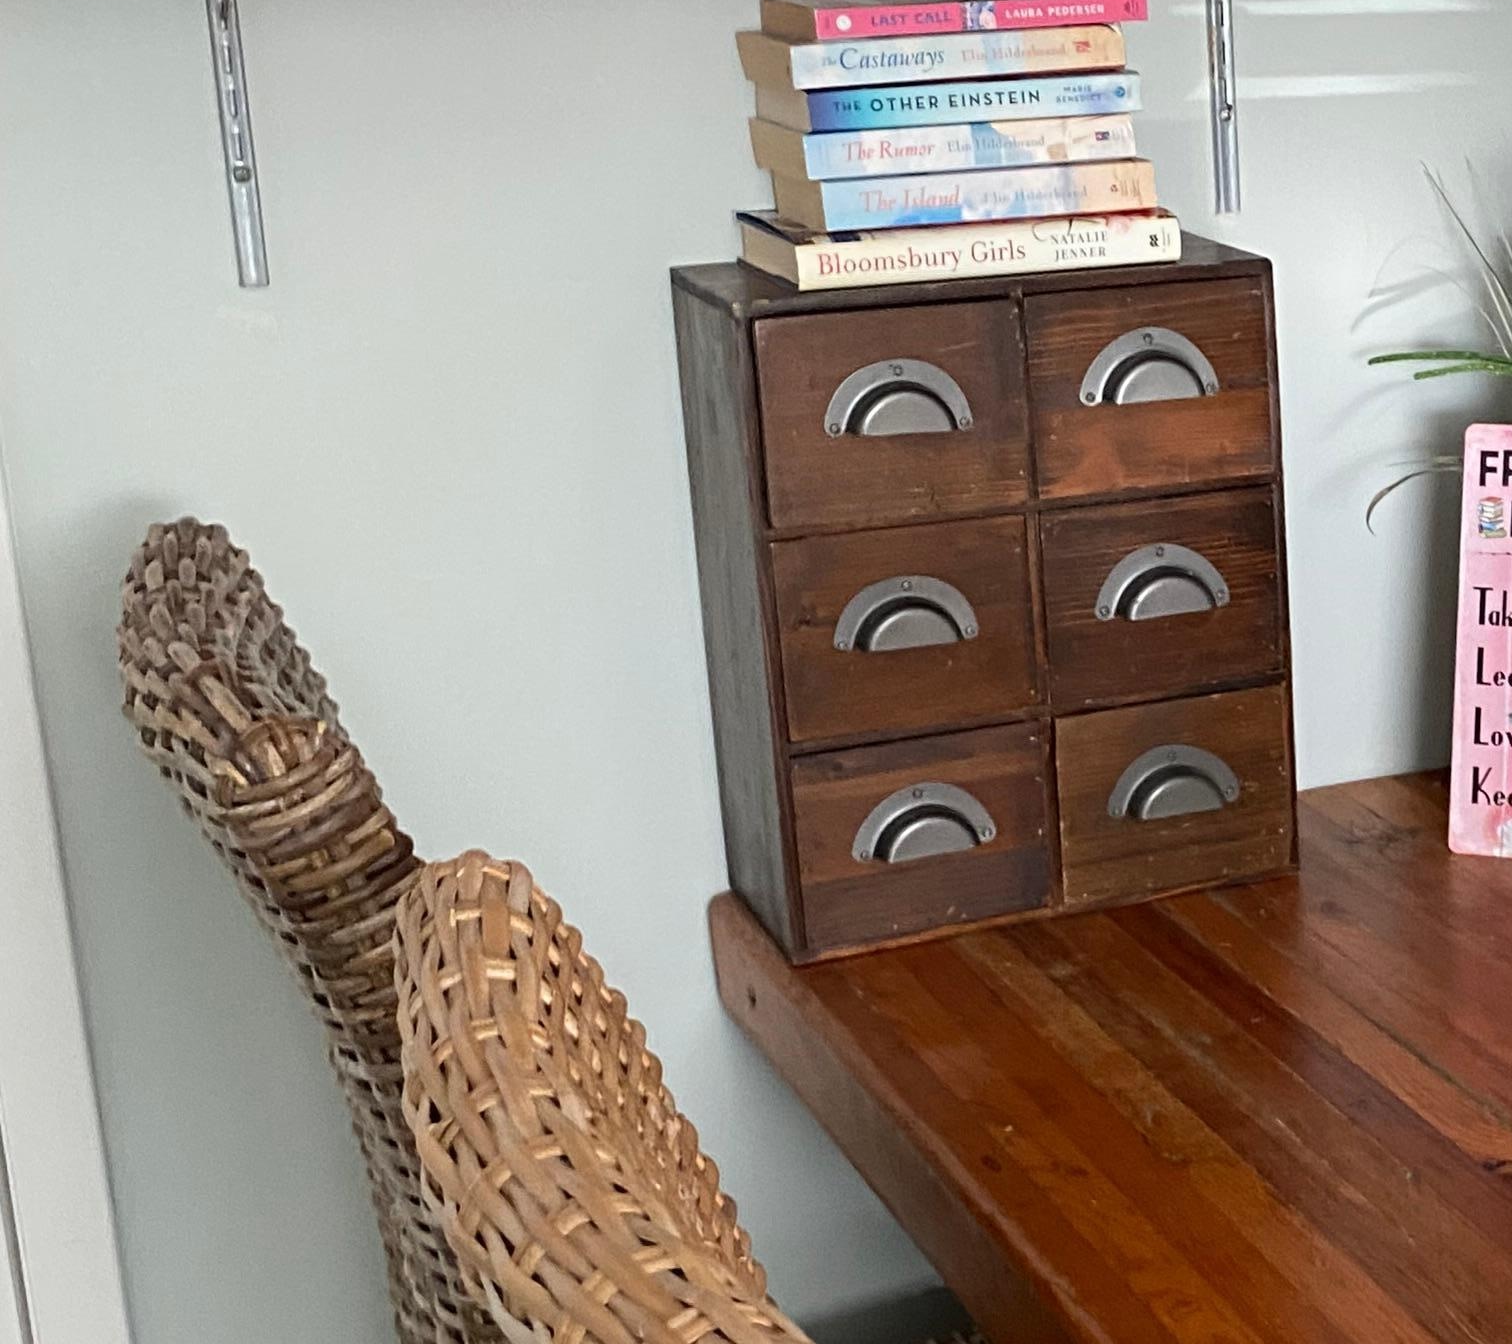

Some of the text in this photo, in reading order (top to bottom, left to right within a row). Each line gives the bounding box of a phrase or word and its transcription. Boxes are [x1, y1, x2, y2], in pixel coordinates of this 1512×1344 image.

[871, 4, 1105, 26] LAST CALL LAURA PEDERSEN
[839, 47, 945, 69] Castaways
[871, 90, 1040, 111] OTHER EINSTEIN
[843, 139, 935, 161] The Rumor
[859, 186, 960, 212] The Island
[818, 239, 1025, 274] Bloomsbury Girls
[1055, 247, 1107, 260] JENNER
